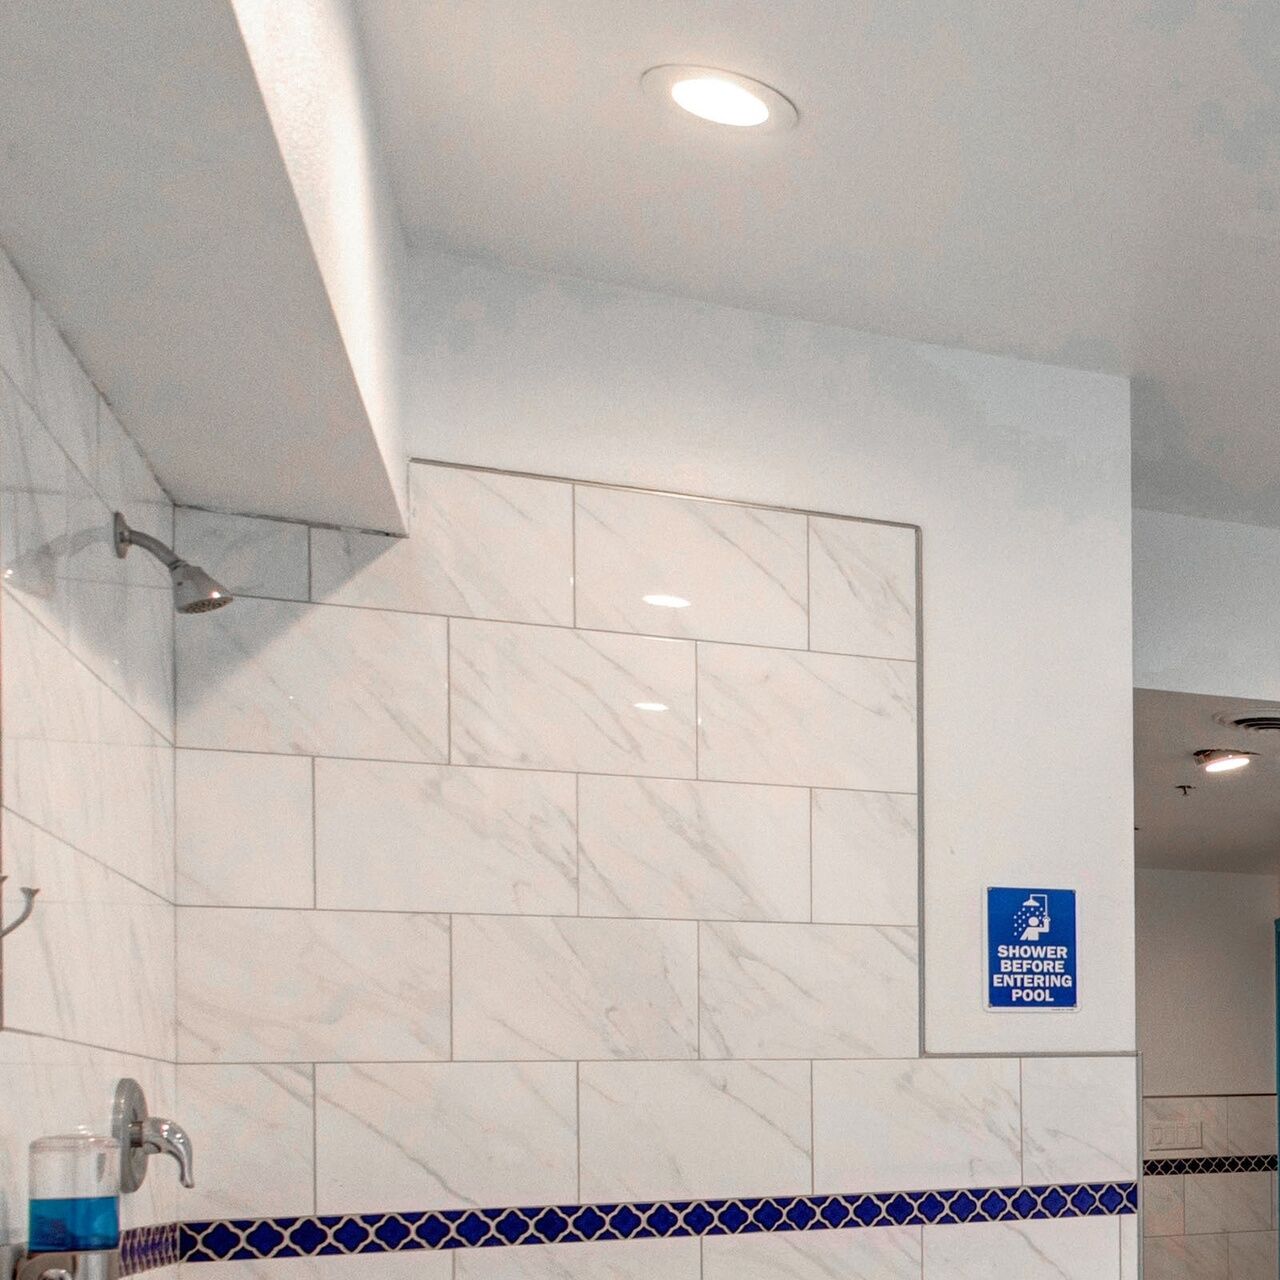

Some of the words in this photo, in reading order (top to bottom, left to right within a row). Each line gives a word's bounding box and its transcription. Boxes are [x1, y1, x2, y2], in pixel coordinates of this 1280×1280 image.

[997, 945, 1067, 959] SHOWER
[1000, 959, 1065, 973] BEFORE
[993, 974, 1072, 987] ENTERING
[1011, 989, 1054, 1002] POOL
